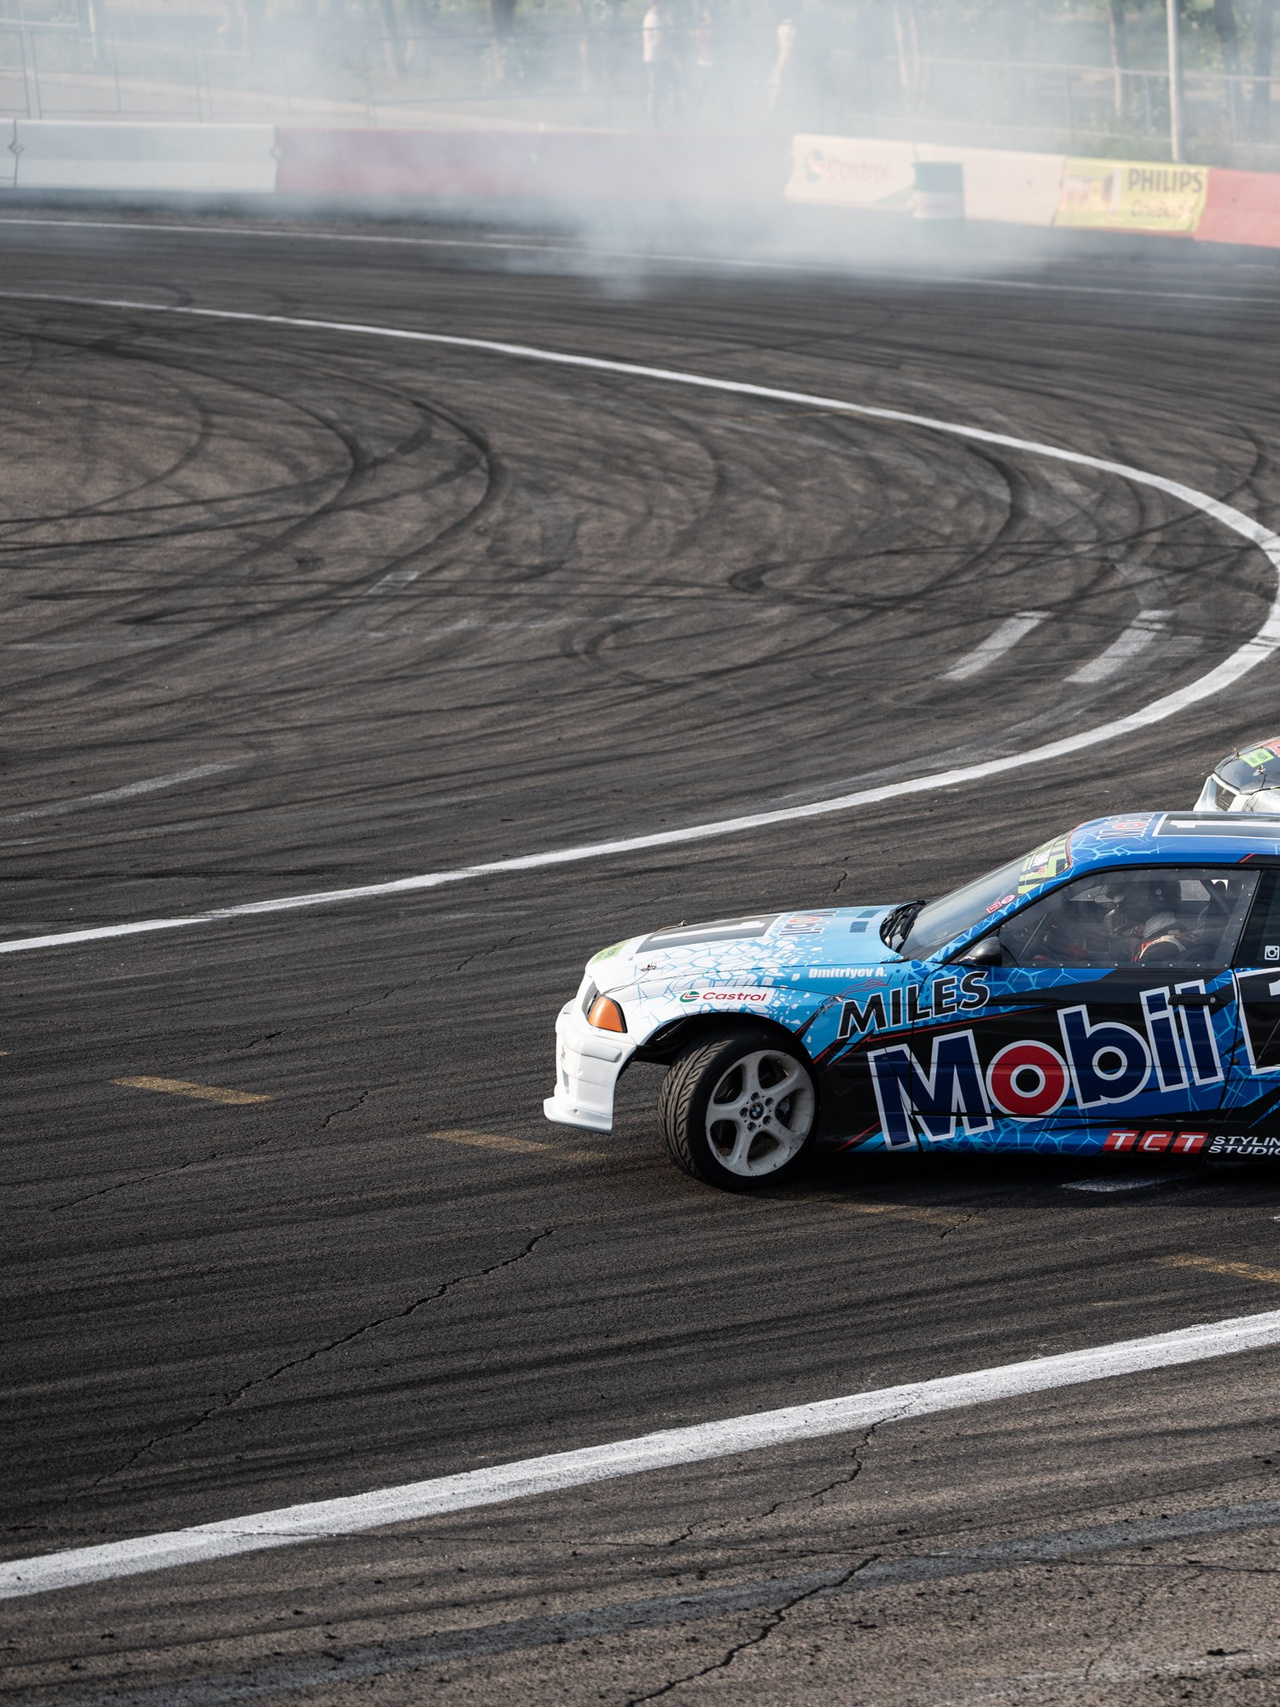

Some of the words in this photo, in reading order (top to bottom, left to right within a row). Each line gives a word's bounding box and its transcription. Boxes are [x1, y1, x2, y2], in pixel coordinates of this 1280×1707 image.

[1127, 167, 1203, 193] PHILIPS
[808, 967, 874, 979] Dmitriyev
[875, 966, 888, 978] A.
[702, 990, 767, 1002] Castrol
[837, 971, 990, 1039] MILES
[867, 979, 1225, 1150] Mobil
[1111, 1132, 1204, 1152] TCT
